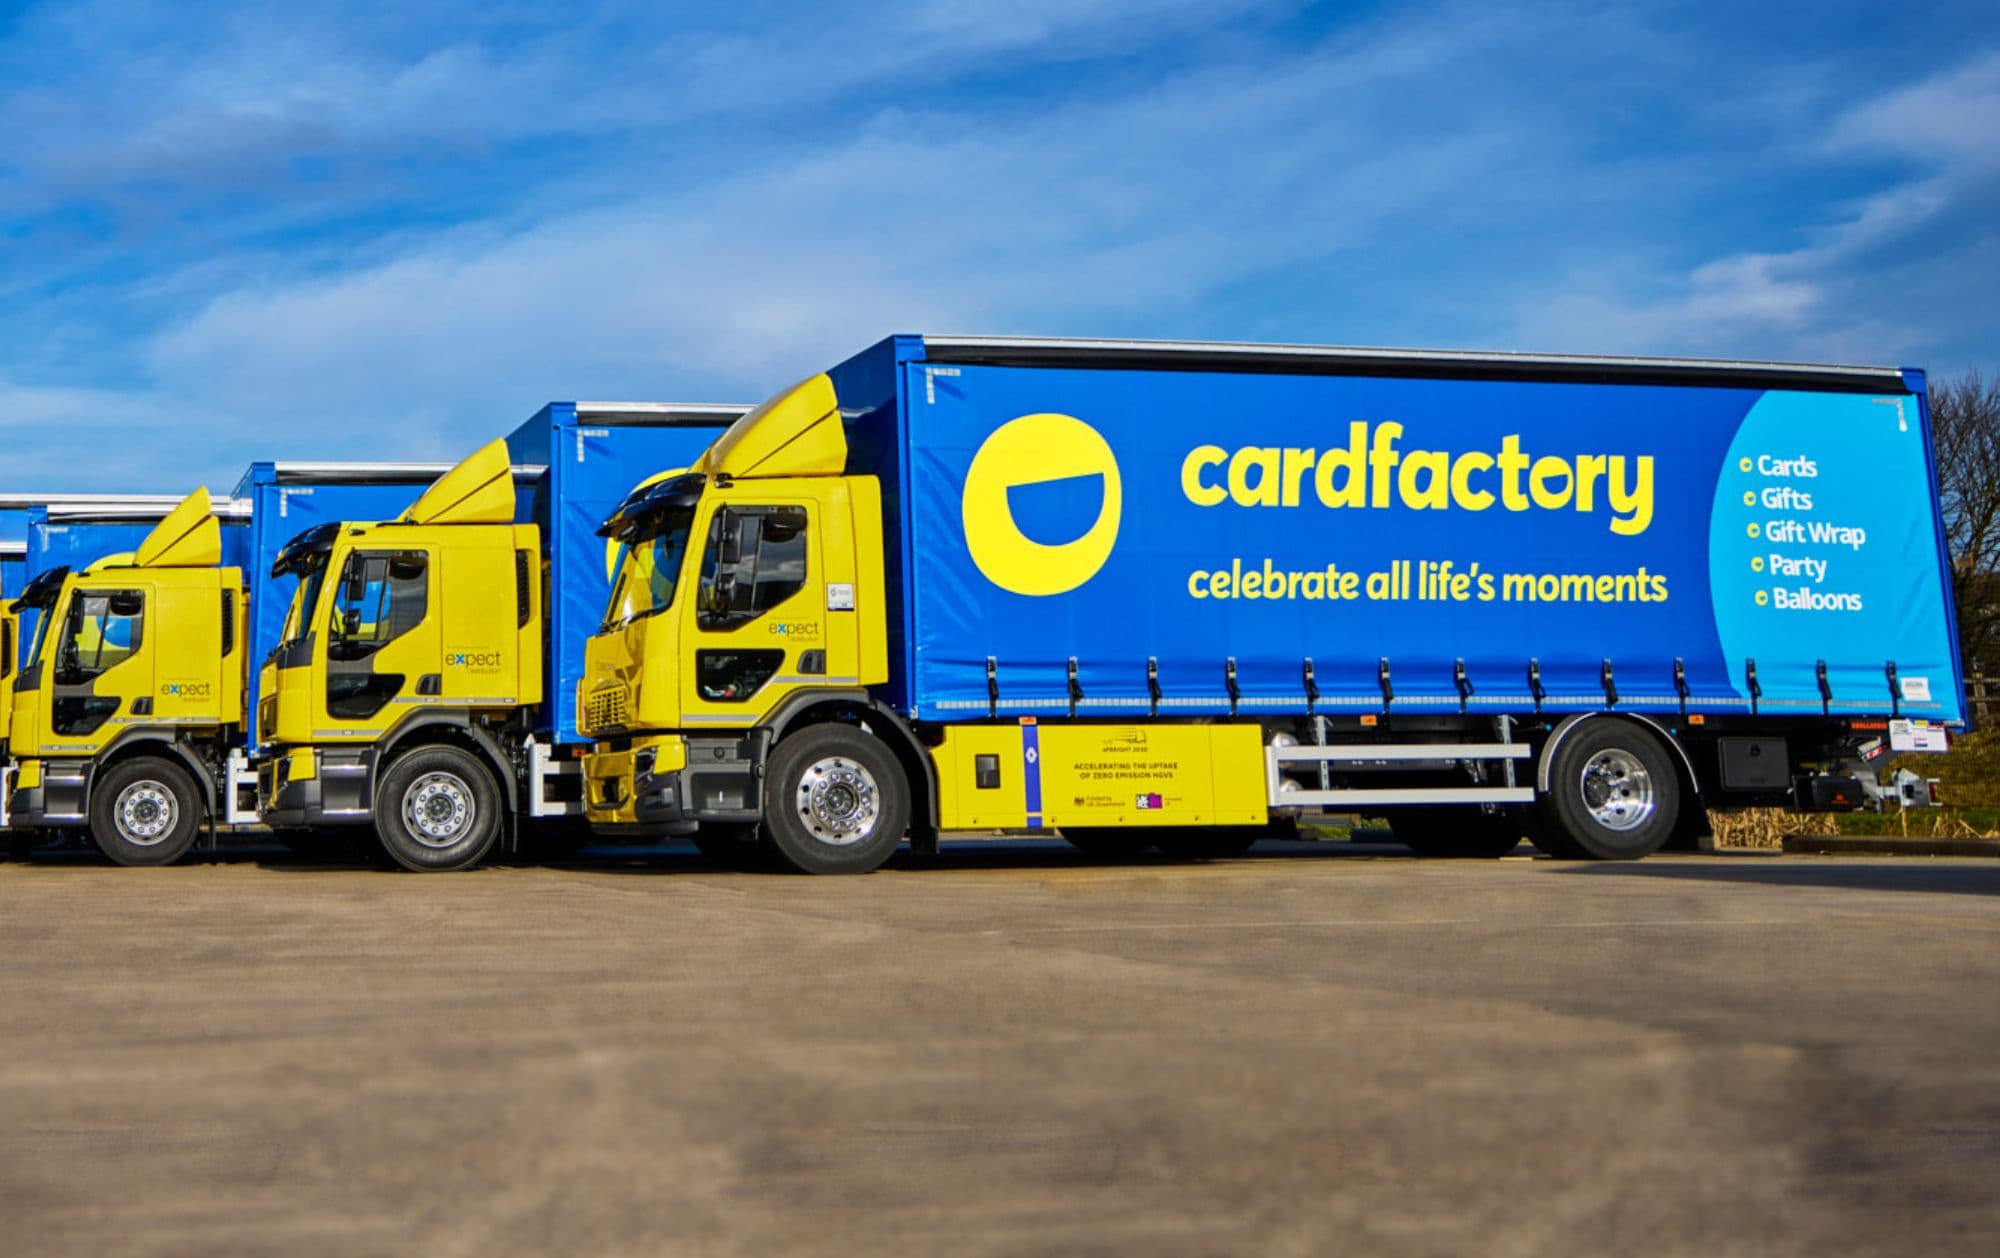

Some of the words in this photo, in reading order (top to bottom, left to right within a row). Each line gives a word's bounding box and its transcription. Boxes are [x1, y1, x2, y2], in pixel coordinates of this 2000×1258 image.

[1757, 454, 1818, 478] Cards
[1181, 420, 1654, 536] cardfactory
[1761, 487, 1813, 510] Gifts
[1765, 520, 1806, 543] Gift
[1807, 522, 1866, 550] Wrap
[1769, 554, 1827, 582] Party
[1188, 558, 1360, 600] celebrate
[1366, 560, 1410, 600] all
[1418, 560, 1496, 602] life's
[1503, 566, 1668, 602] moments
[1773, 587, 1863, 611] Balloons
[768, 621, 819, 637] expect
[445, 650, 501, 669] expect
[161, 681, 210, 698] expect
[1074, 762, 1131, 770] ACCELERATING
[1133, 762, 1147, 770] THE
[1149, 762, 1178, 770] UPTAKE
[1080, 771, 1090, 779] OF
[1092, 771, 1114, 779] ZERO
[1115, 771, 1151, 779] EMISSION
